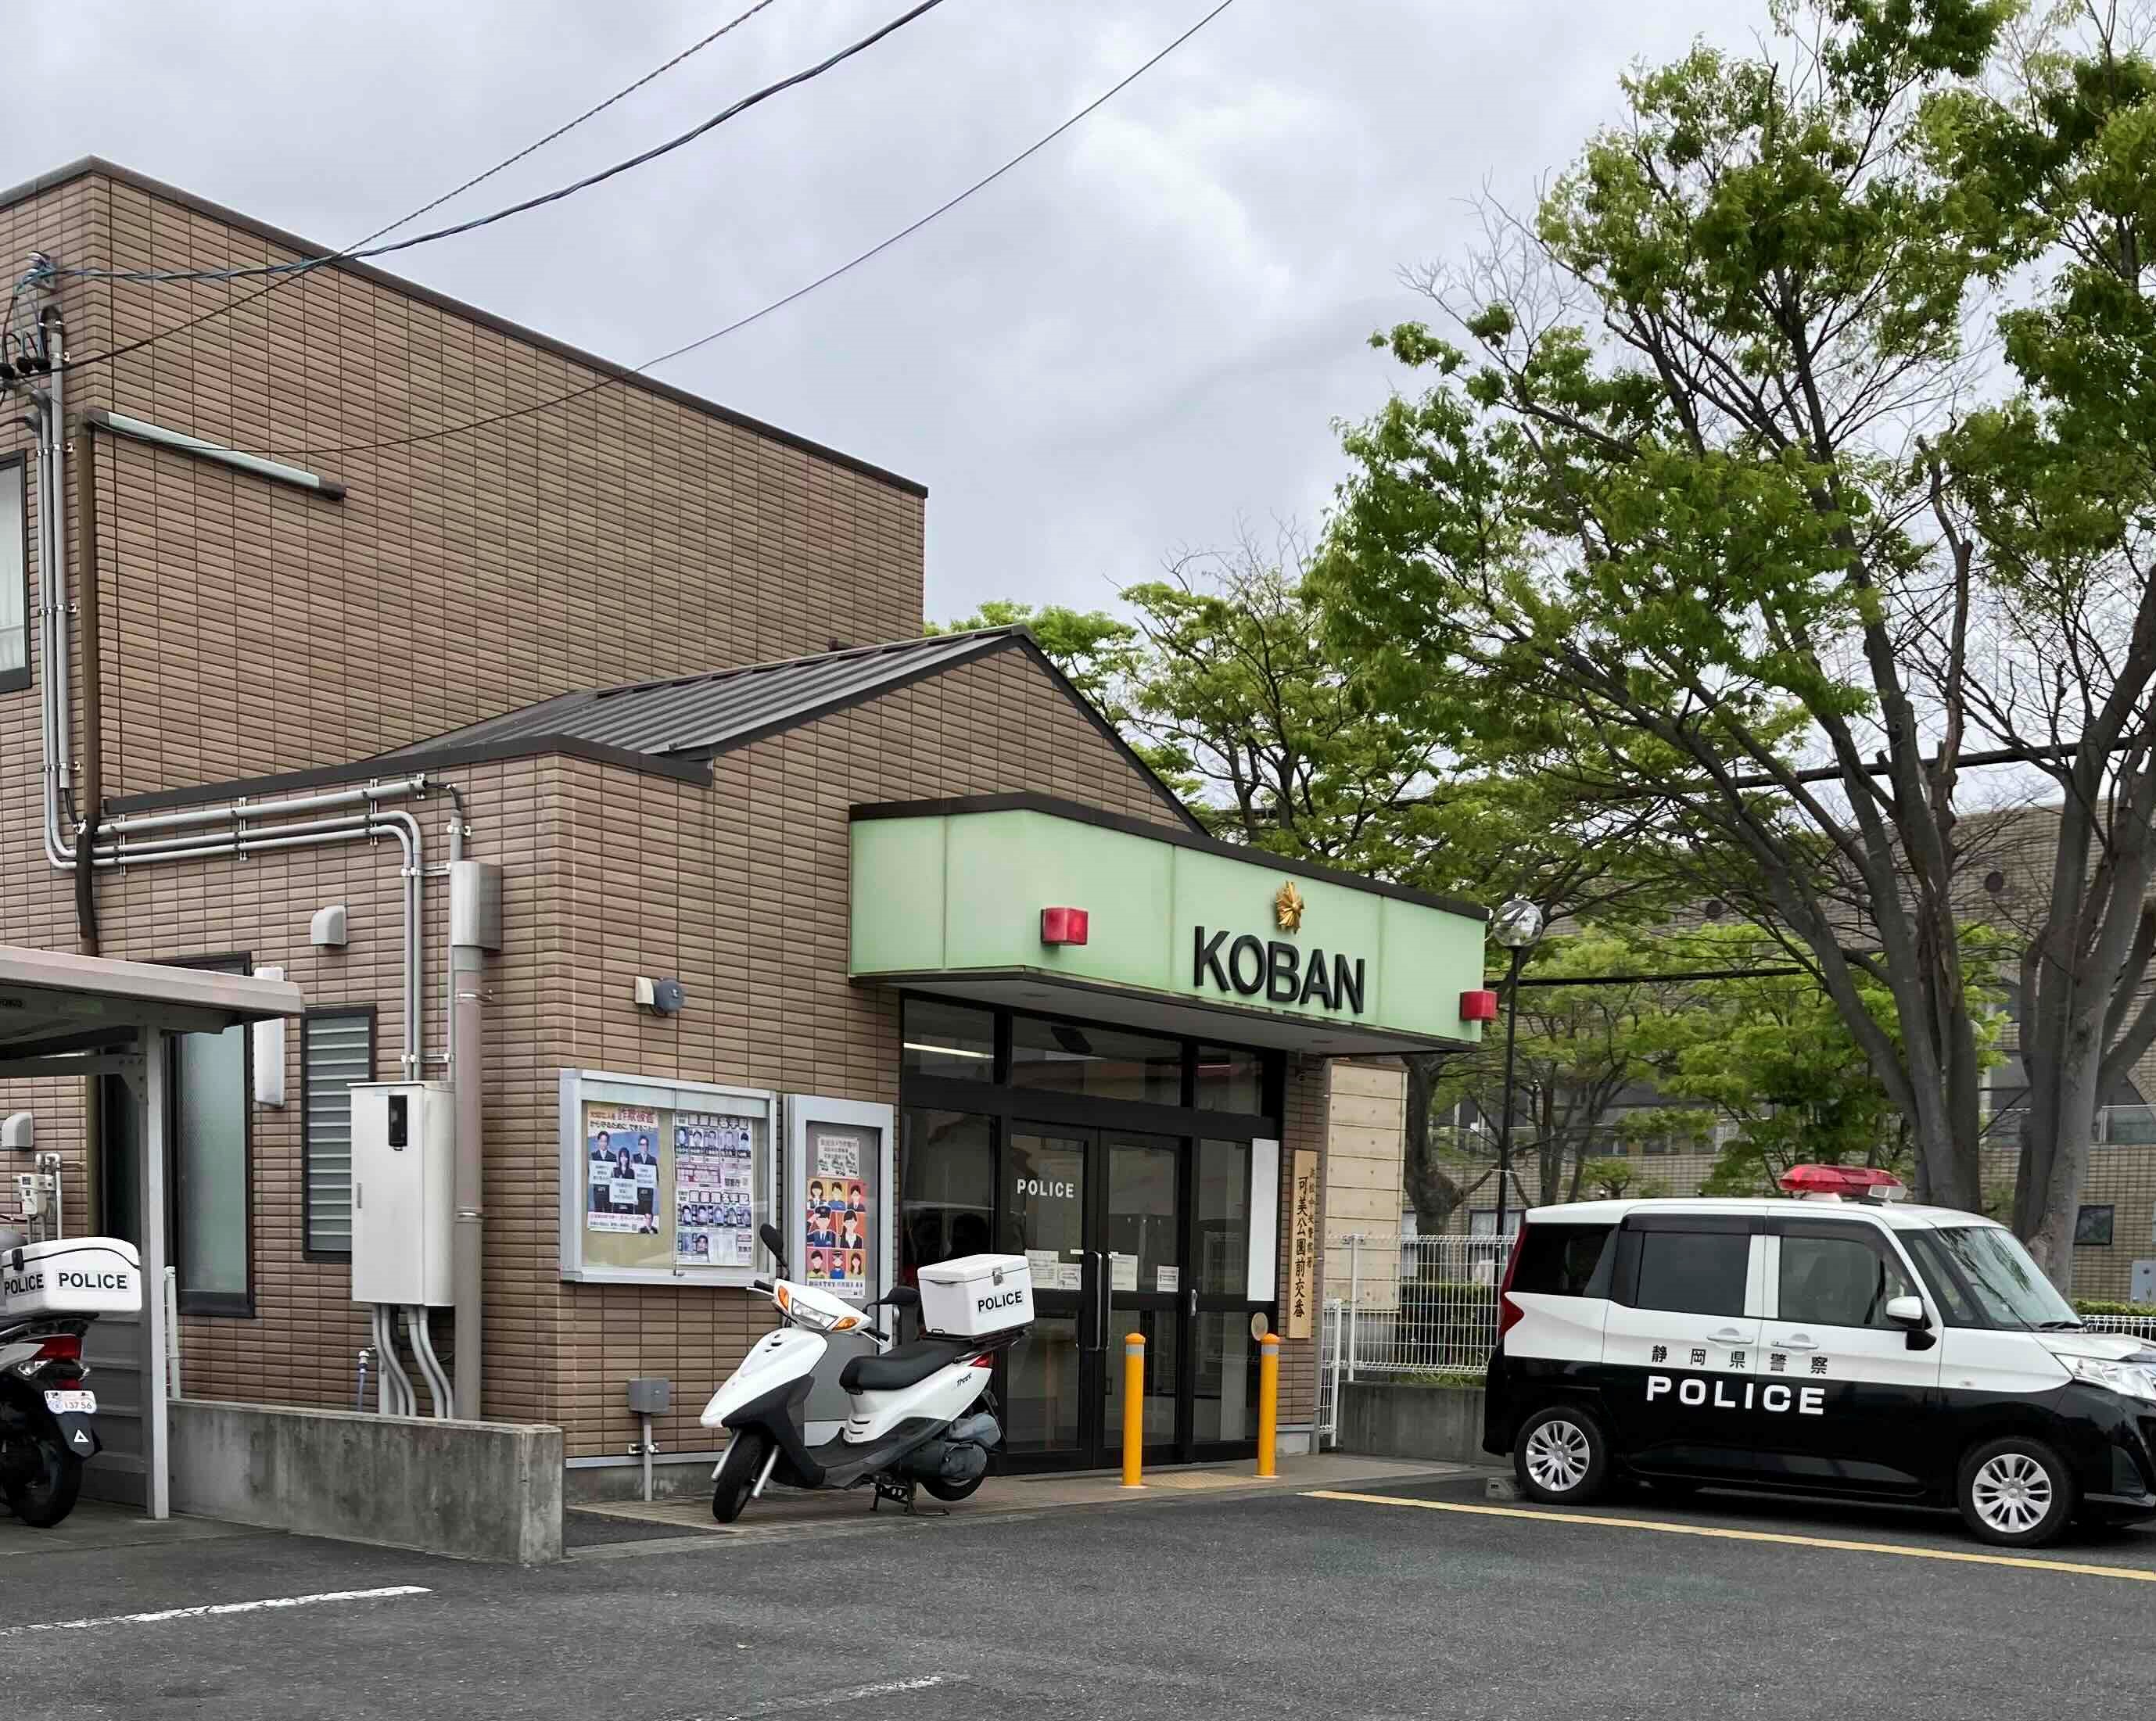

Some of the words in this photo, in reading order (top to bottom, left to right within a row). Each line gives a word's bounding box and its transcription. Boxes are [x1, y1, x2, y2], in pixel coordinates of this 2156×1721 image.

[1194, 926, 1365, 1013] KOBAN
[1017, 1178, 1074, 1198] POLICE
[1293, 1177, 1308, 1318] 可美公園前交番
[5, 1274, 45, 1295] POLICE
[59, 1272, 127, 1289] POLICE
[978, 1291, 1023, 1313] POLICE
[1652, 1345, 1828, 1375] 静岡県警察
[1646, 1375, 1826, 1415] POLICE
